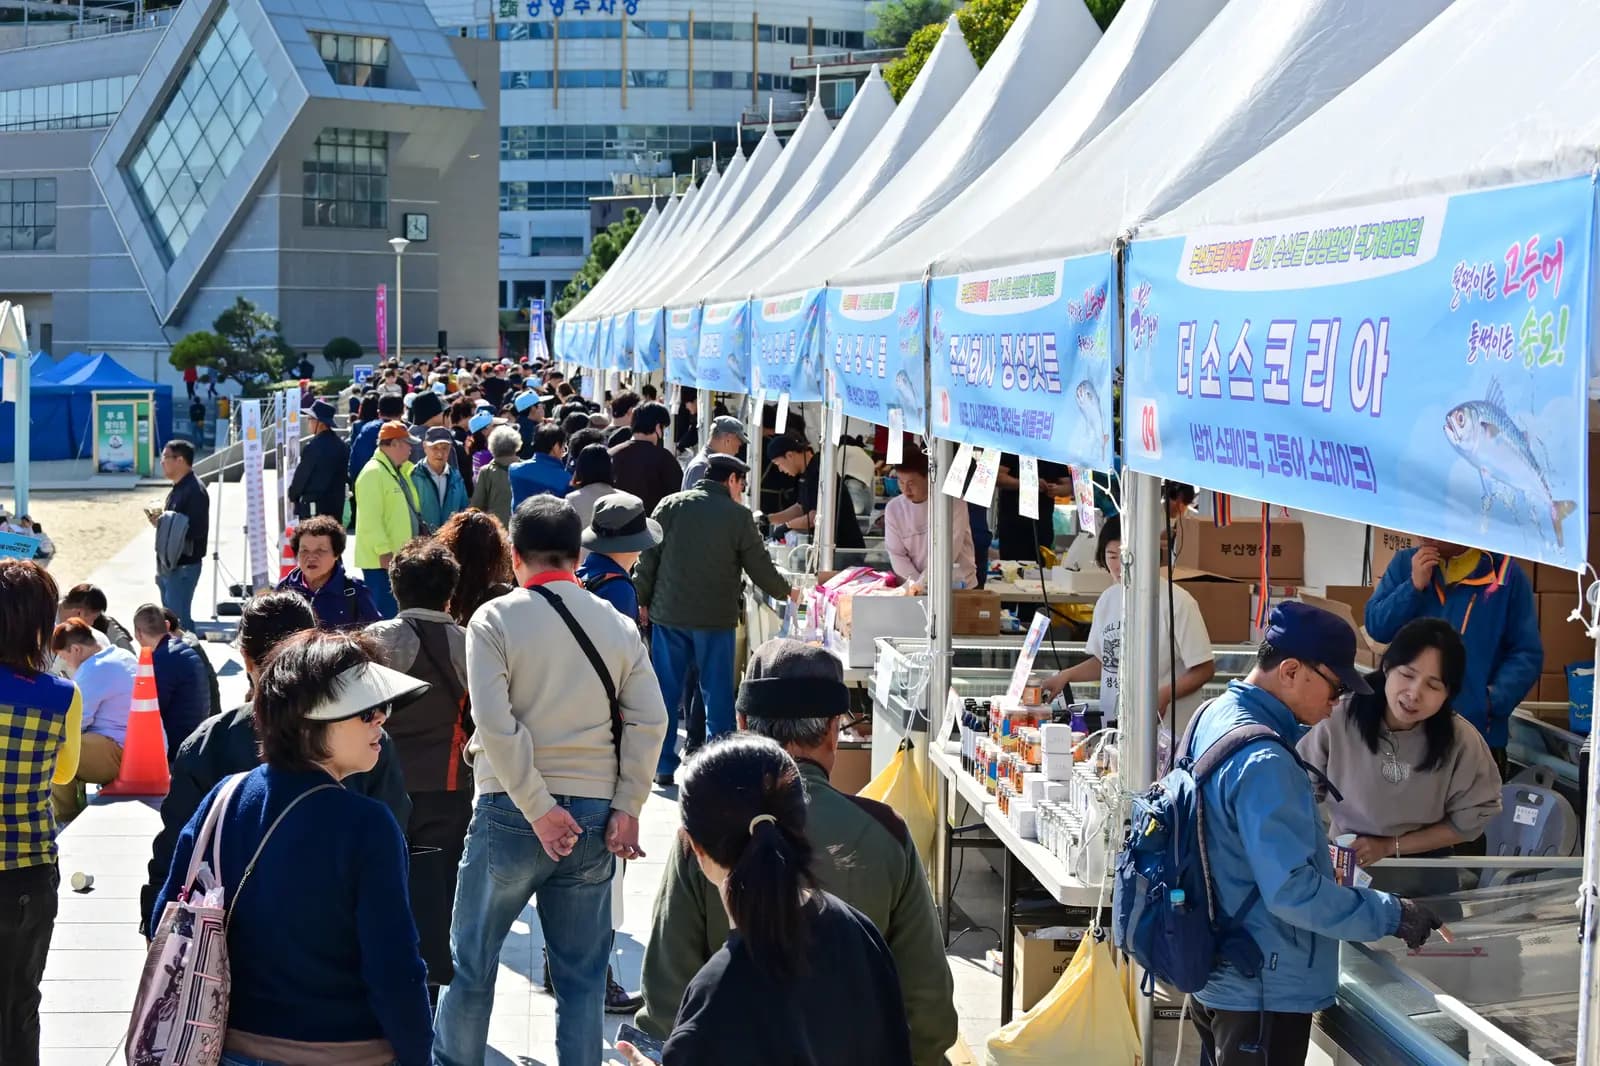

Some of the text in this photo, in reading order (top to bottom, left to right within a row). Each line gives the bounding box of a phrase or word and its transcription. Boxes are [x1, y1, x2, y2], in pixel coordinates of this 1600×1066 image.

[1354, 216, 1424, 261] 직거래장터
[1503, 235, 1563, 299] 고등어
[949, 333, 997, 389] 주식회사
[1000, 331, 1062, 393] 정성깃든
[1519, 307, 1568, 366] 송도!
[1176, 317, 1390, 417] 더소스코리아
[1142, 405, 1156, 451] 09
[1264, 432, 1307, 480] 고등어
[1308, 439, 1377, 493] 스테이크)
[1220, 543, 1283, 557] 부산정품
